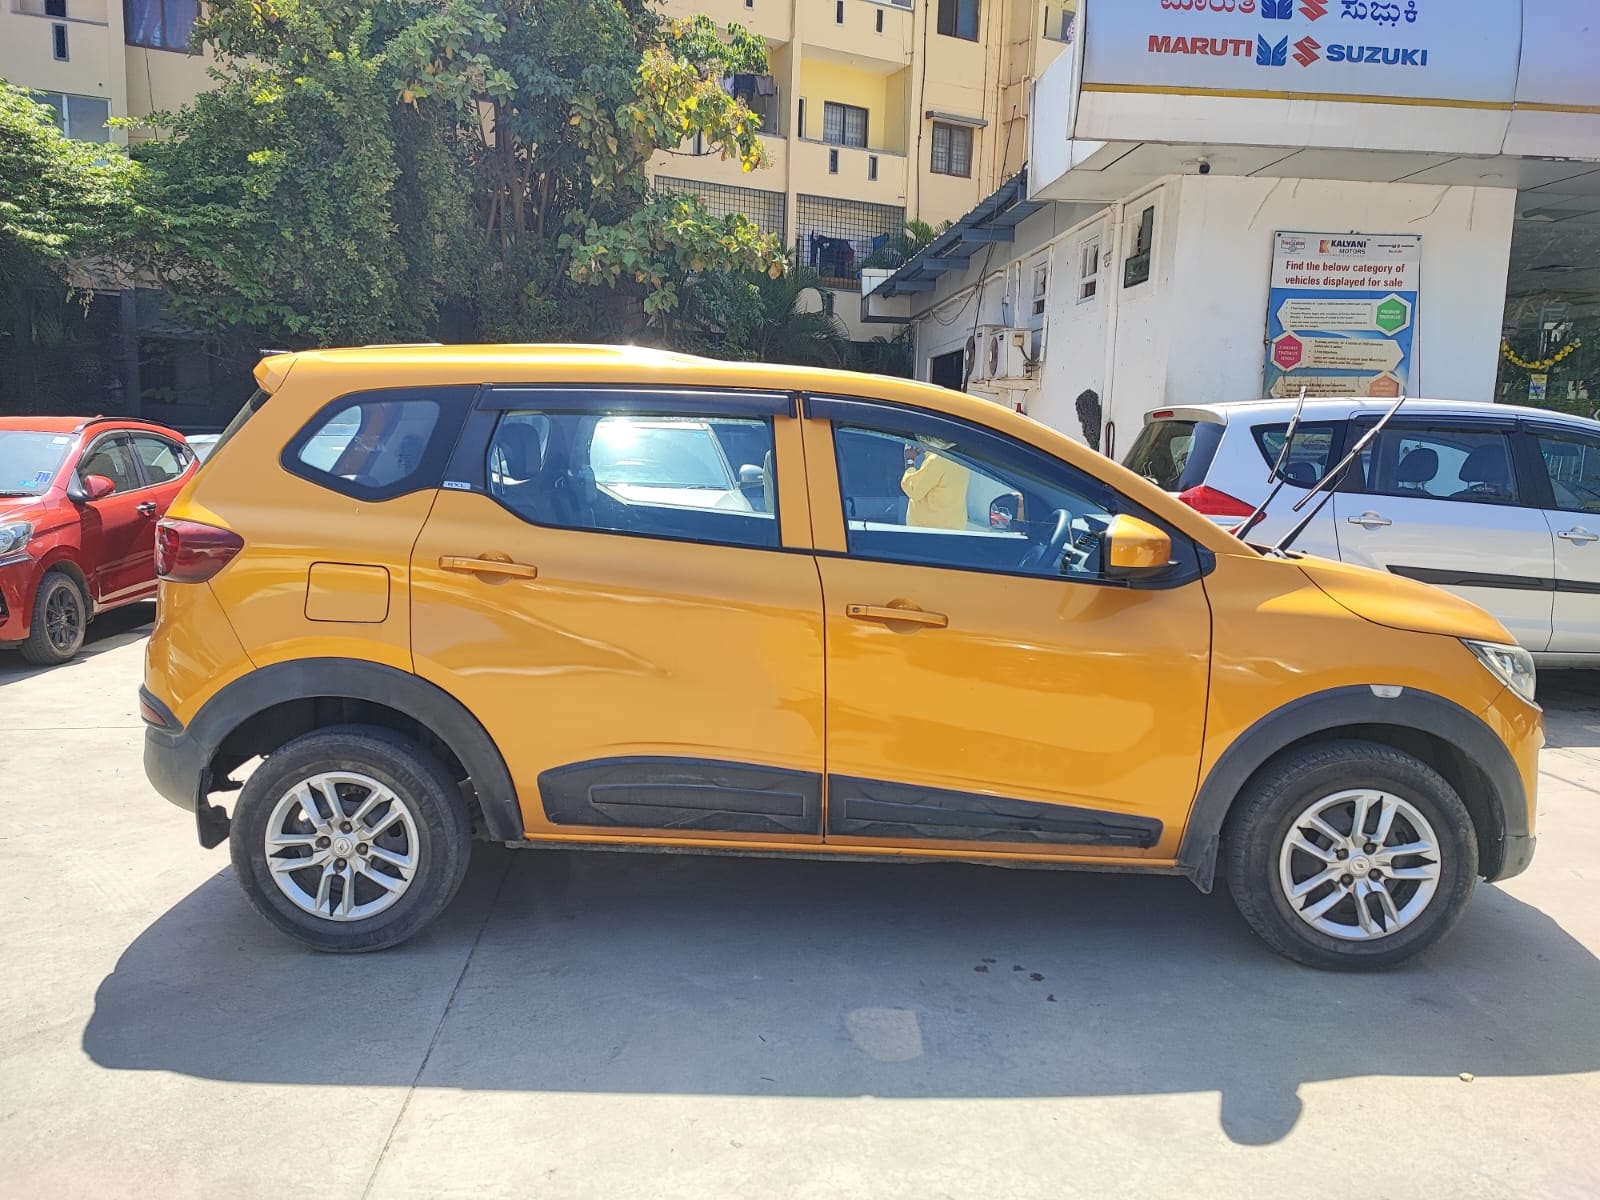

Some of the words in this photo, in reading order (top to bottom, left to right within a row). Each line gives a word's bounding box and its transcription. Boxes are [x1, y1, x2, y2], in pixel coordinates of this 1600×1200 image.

[1148, 35, 1253, 57] MARUTI
[1326, 44, 1428, 66] SUZUKI
[1331, 240, 1366, 249] KALYANI
[1286, 260, 1304, 271] Find
[1306, 261, 1320, 271] the
[1322, 262, 1350, 272] below
[1352, 264, 1393, 275] category
[1395, 263, 1406, 273] of
[1285, 275, 1320, 285] vehicles
[1323, 276, 1365, 288] displayed
[1368, 277, 1381, 287] for
[1383, 278, 1403, 287] sale
